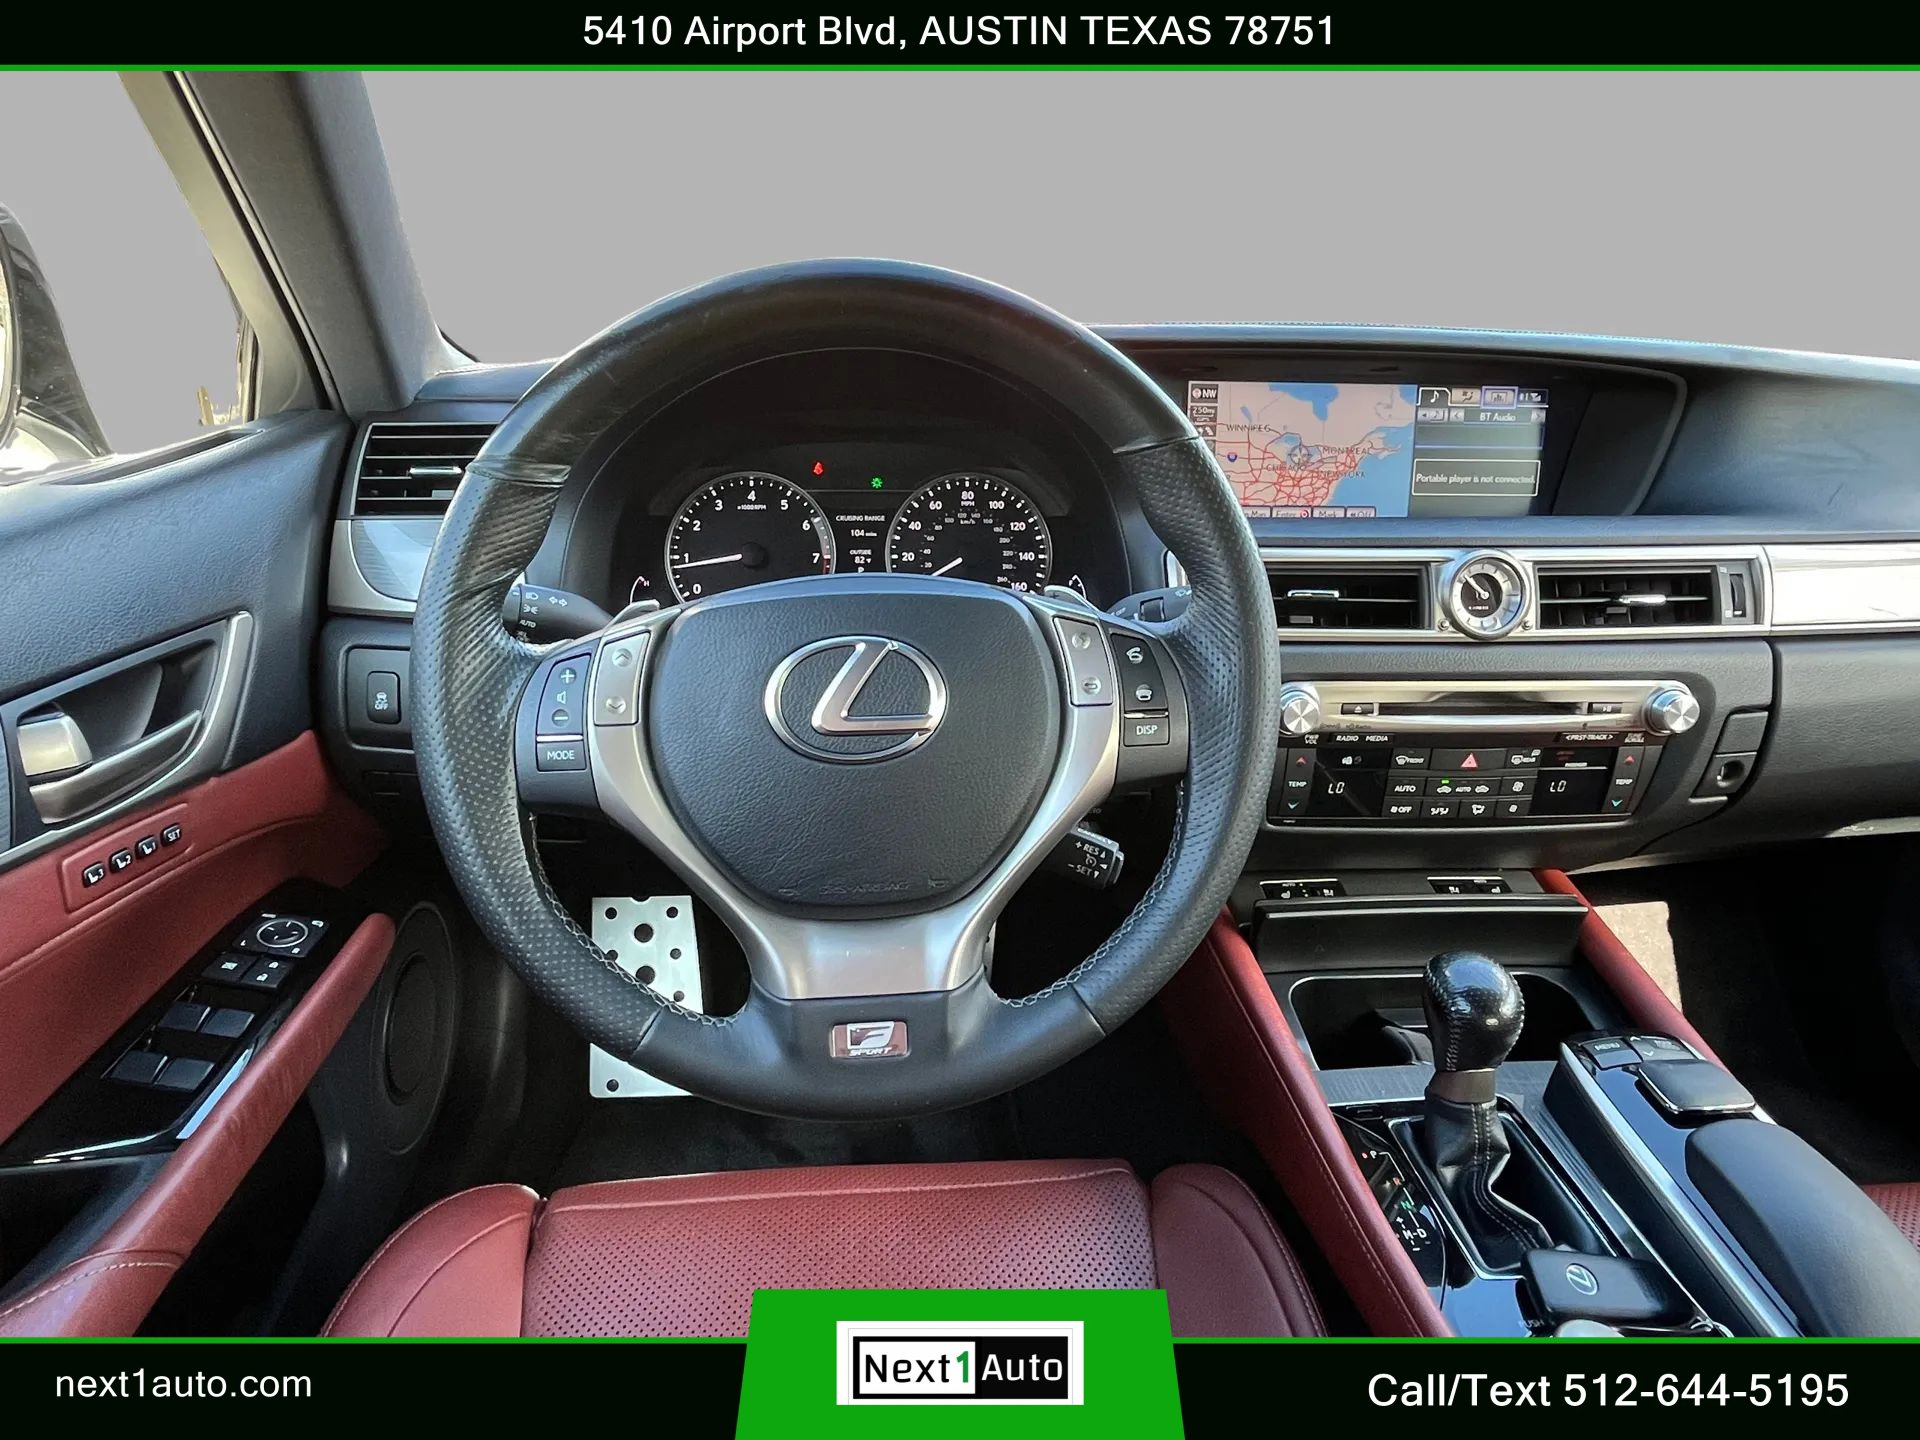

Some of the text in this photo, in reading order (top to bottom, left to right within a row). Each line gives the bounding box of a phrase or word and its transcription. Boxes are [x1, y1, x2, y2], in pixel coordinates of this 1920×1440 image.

[1202, 389, 1217, 399] NW
[1479, 412, 1516, 422] BT Audio
[1226, 424, 1271, 432] WINNIPEG
[1322, 446, 1371, 455] MONTREAL
[1416, 473, 1448, 483] Portable
[1449, 475, 1472, 485] player
[1481, 475, 1494, 483] not
[747, 490, 756, 501] 4
[961, 491, 974, 500] 80
[714, 500, 723, 511] 3
[780, 500, 789, 510] 5
[929, 501, 942, 510] 60
[989, 501, 1004, 510] 100
[692, 520, 701, 531] 2
[802, 520, 811, 531] 6
[908, 522, 921, 531] 40
[1010, 522, 1026, 531] 120
[851, 529, 865, 537] 104
[683, 553, 689, 563] 1
[812, 553, 820, 563] 7
[854, 555, 865, 564] 82
[901, 552, 915, 562] 20
[1018, 552, 1035, 561] 140
[692, 584, 702, 594] 0
[1011, 582, 1028, 592] 160
[519, 619, 536, 629] AUTO
[1136, 725, 1158, 735] DISP
[547, 750, 575, 760] MODE
[1394, 785, 1416, 793] AUTO
[1399, 806, 1412, 814] OFF
[167, 828, 180, 841] SET
[1083, 843, 1100, 855] RES
[1076, 864, 1093, 876] SET
[849, 1047, 892, 1056] SPORT
[1370, 1150, 1377, 1159] P
